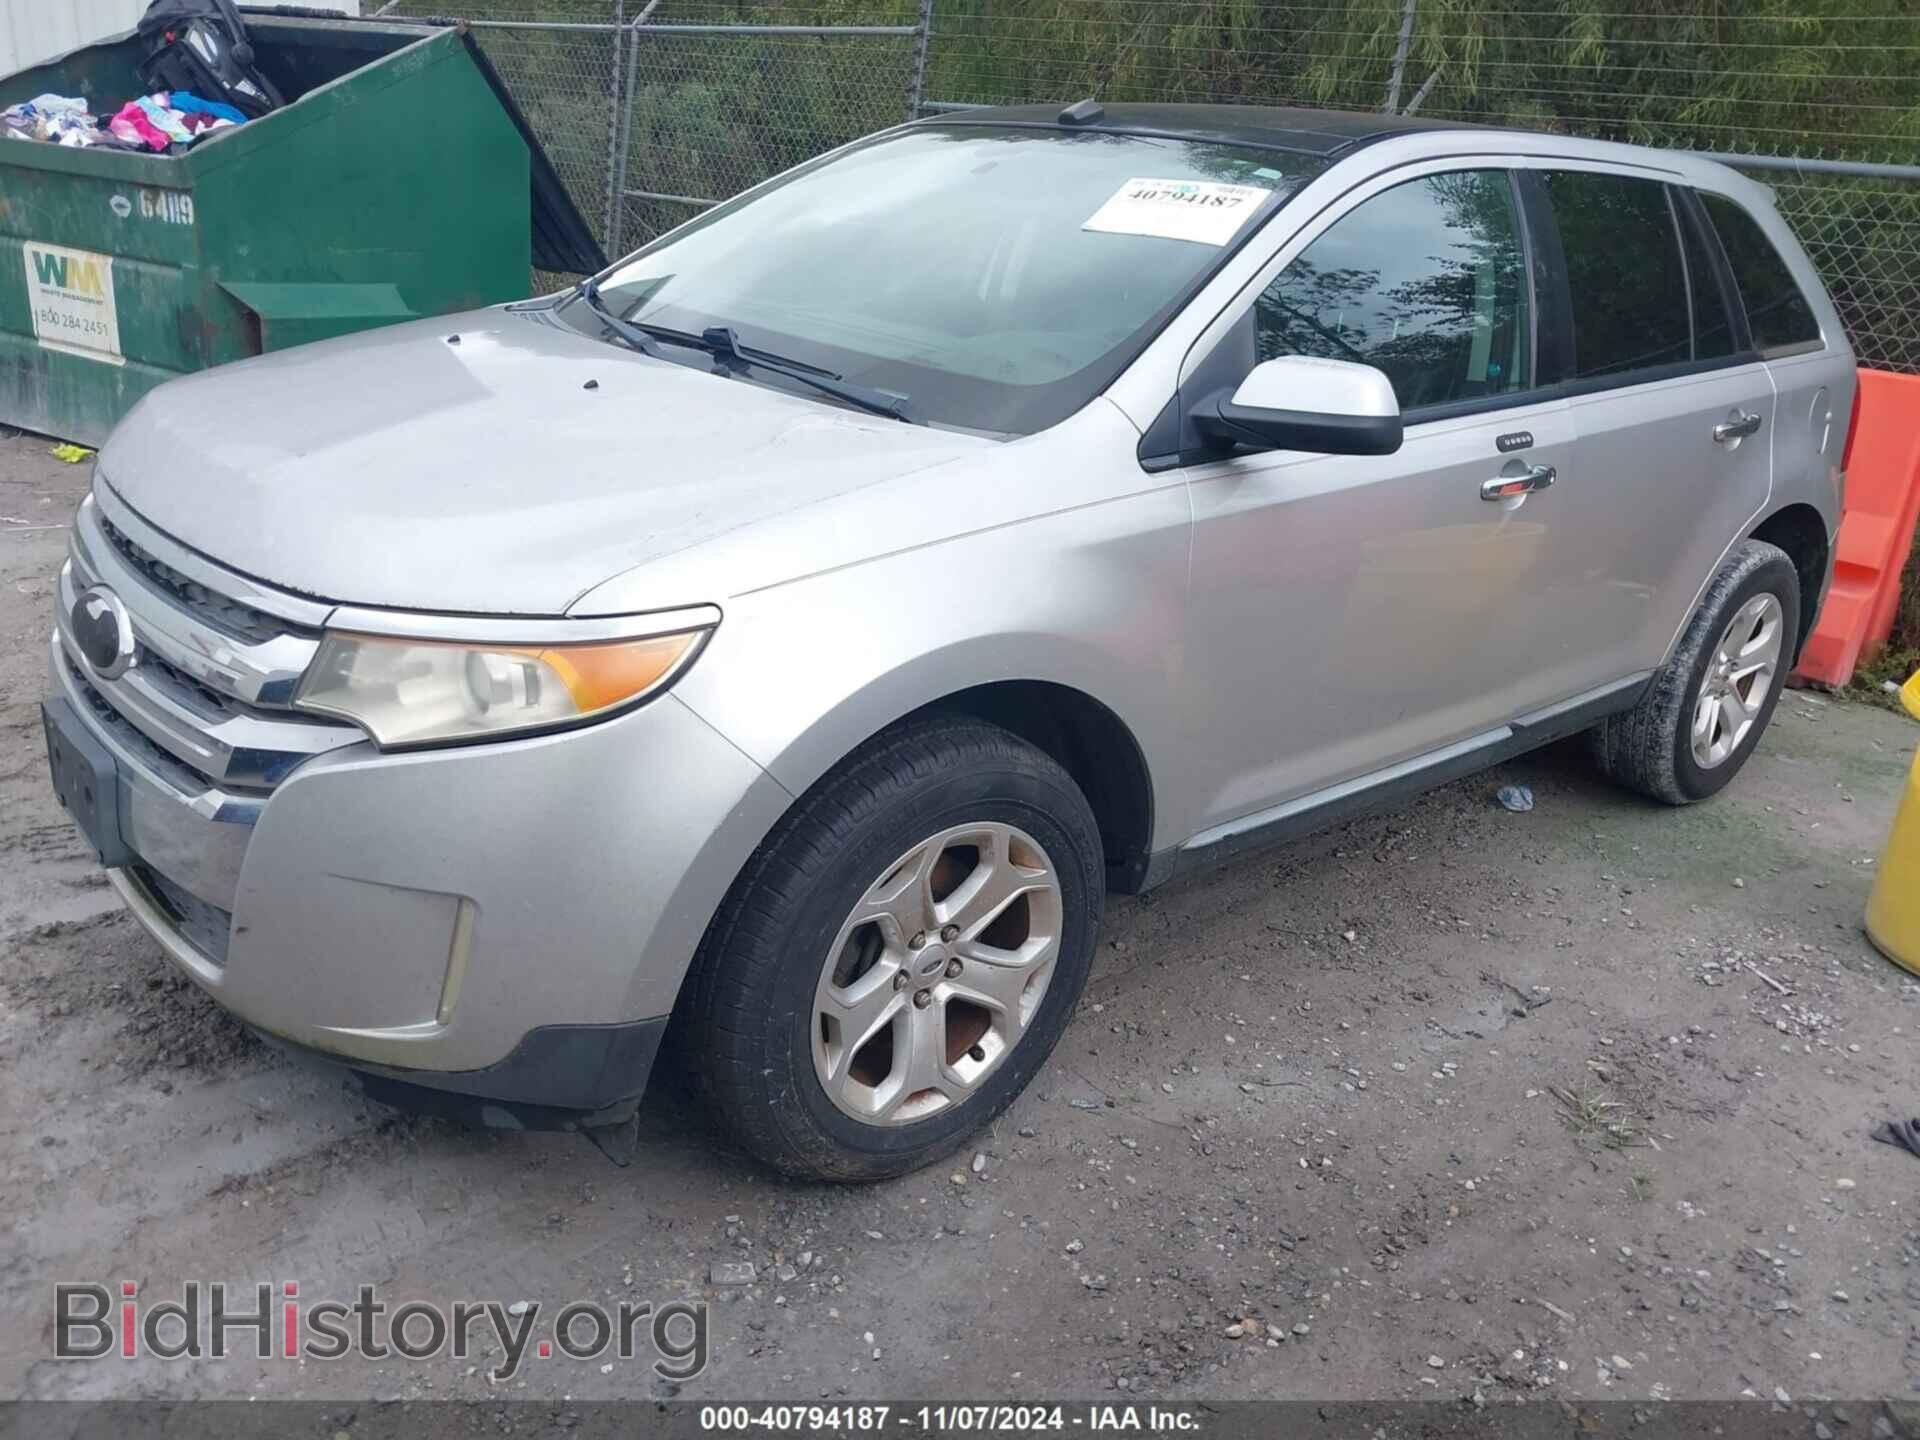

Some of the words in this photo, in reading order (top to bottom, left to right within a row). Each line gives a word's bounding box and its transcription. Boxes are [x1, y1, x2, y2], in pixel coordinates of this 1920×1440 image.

[1128, 190, 1243, 207] 40794187
[32, 251, 102, 296] WM
[41, 309, 59, 325] 800
[62, 313, 80, 328] 284
[83, 319, 108, 336] 2451
